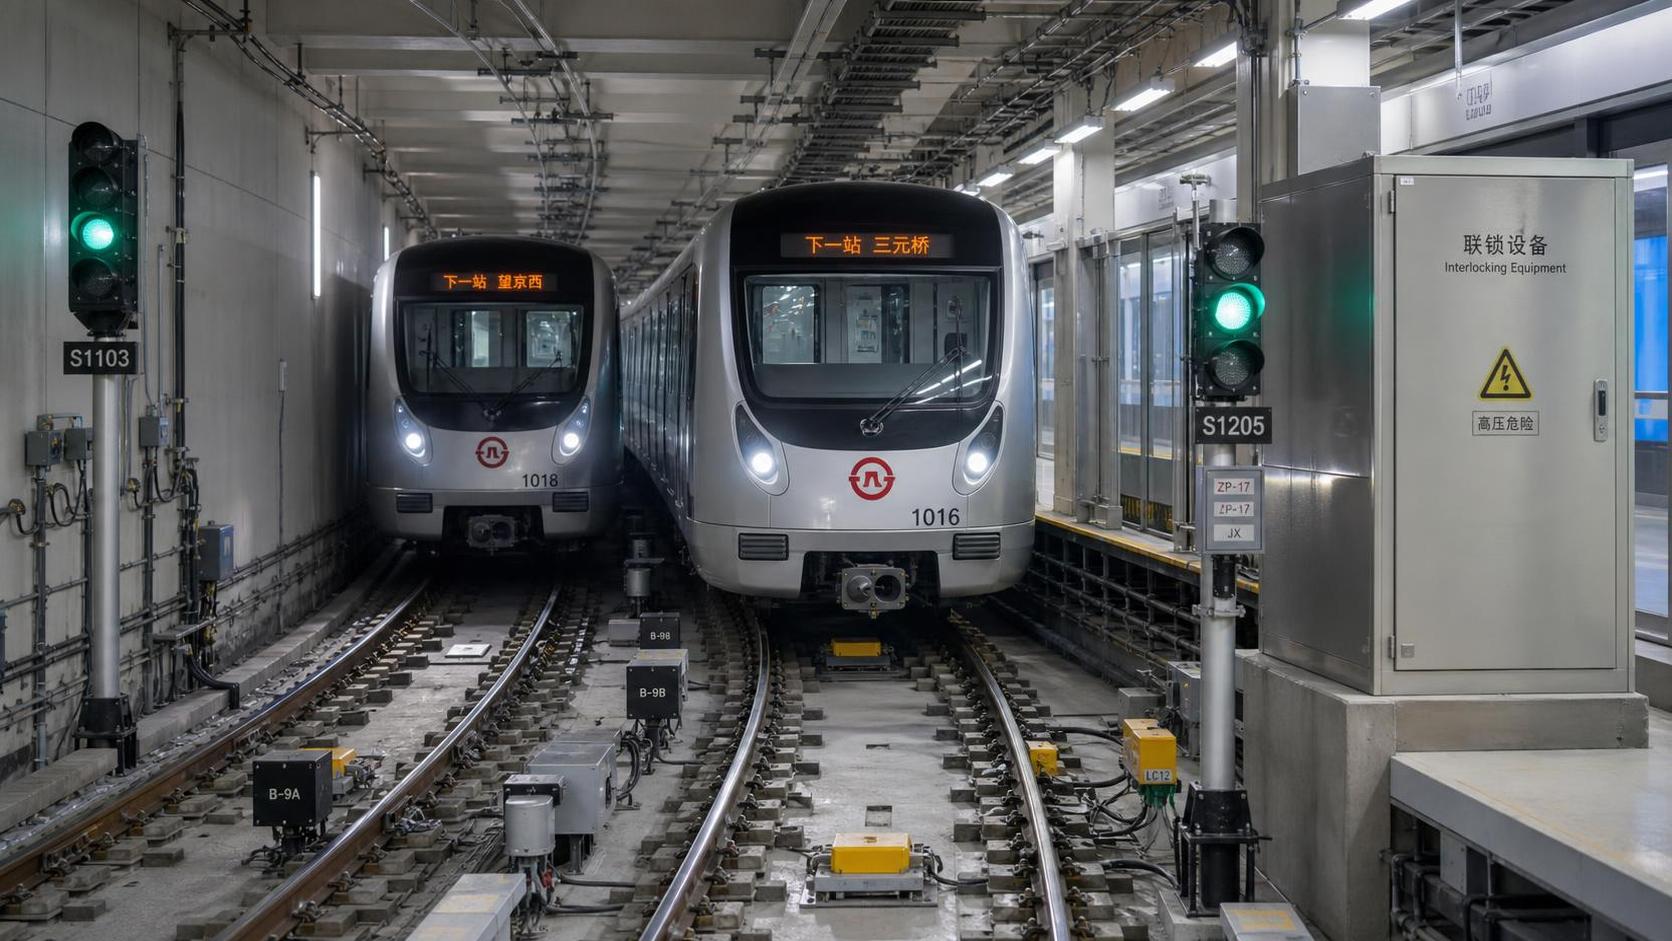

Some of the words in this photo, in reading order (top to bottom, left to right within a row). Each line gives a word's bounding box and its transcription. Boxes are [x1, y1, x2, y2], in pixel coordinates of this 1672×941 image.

[805, 236, 862, 254] 下一站
[873, 236, 930, 254] 三元桥
[1463, 234, 1548, 256] 联锁设备
[1445, 262, 1507, 275] Interlocking
[1511, 262, 1567, 275] Equipment
[443, 274, 487, 290] 下一站
[497, 274, 543, 290] 望京西
[69, 349, 130, 367] S1103
[1202, 416, 1265, 436] S1205
[1477, 416, 1534, 431] 高压危险
[522, 474, 559, 488] 1018
[1217, 481, 1250, 493] ZP-17
[912, 508, 960, 526] 1016
[1228, 528, 1241, 538] JX
[640, 687, 666, 698] B-9B
[1146, 770, 1170, 781] LC12
[269, 788, 301, 800] B-9A
